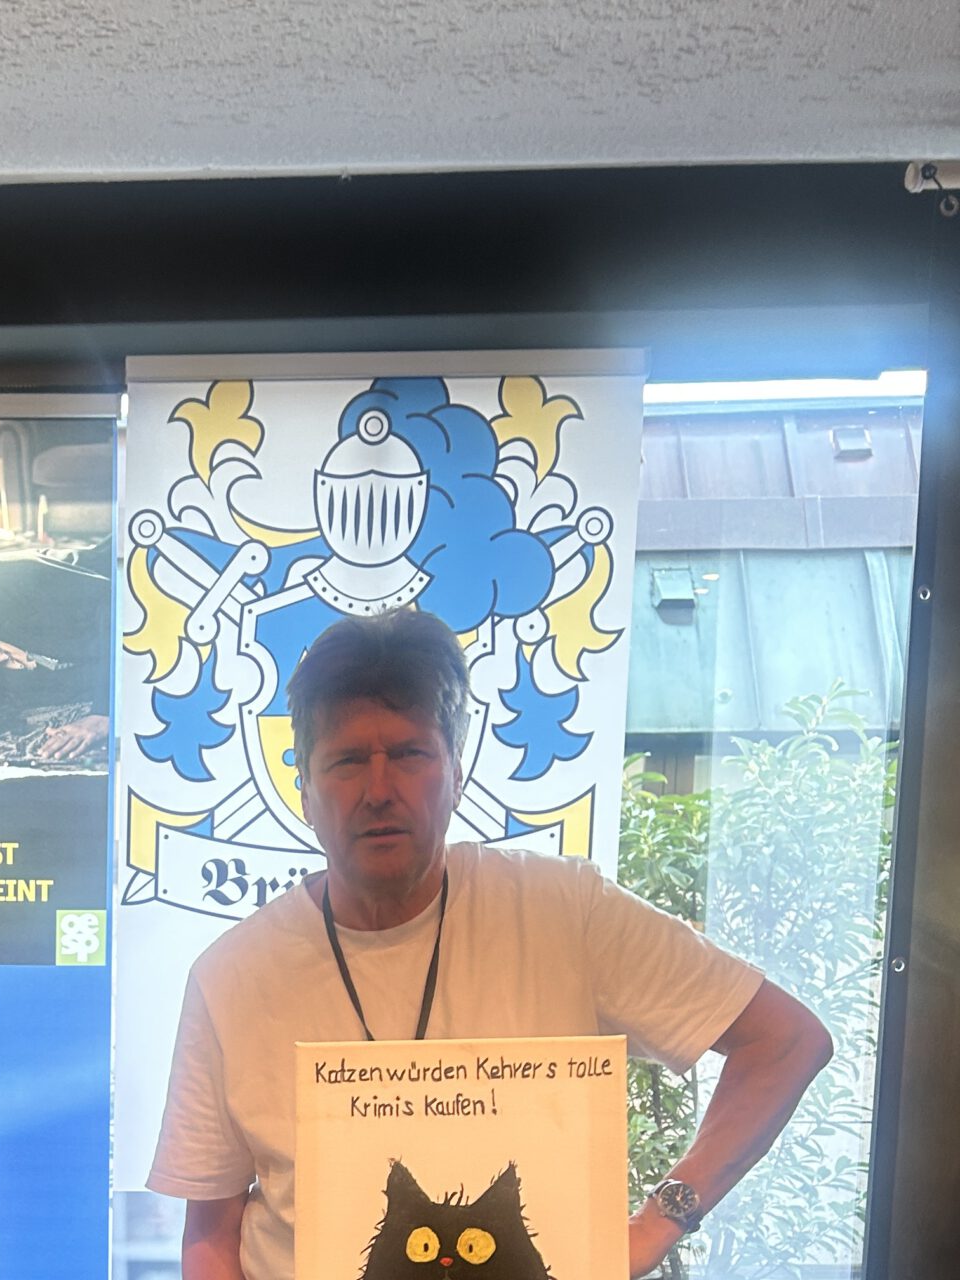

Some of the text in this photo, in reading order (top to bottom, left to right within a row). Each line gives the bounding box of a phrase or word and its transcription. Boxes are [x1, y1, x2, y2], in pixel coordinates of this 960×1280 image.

[315, 1058, 382, 1084] Katzen
[386, 1060, 468, 1082] würden
[568, 1056, 613, 1078] tolle
[350, 1095, 415, 1118] Krimis
